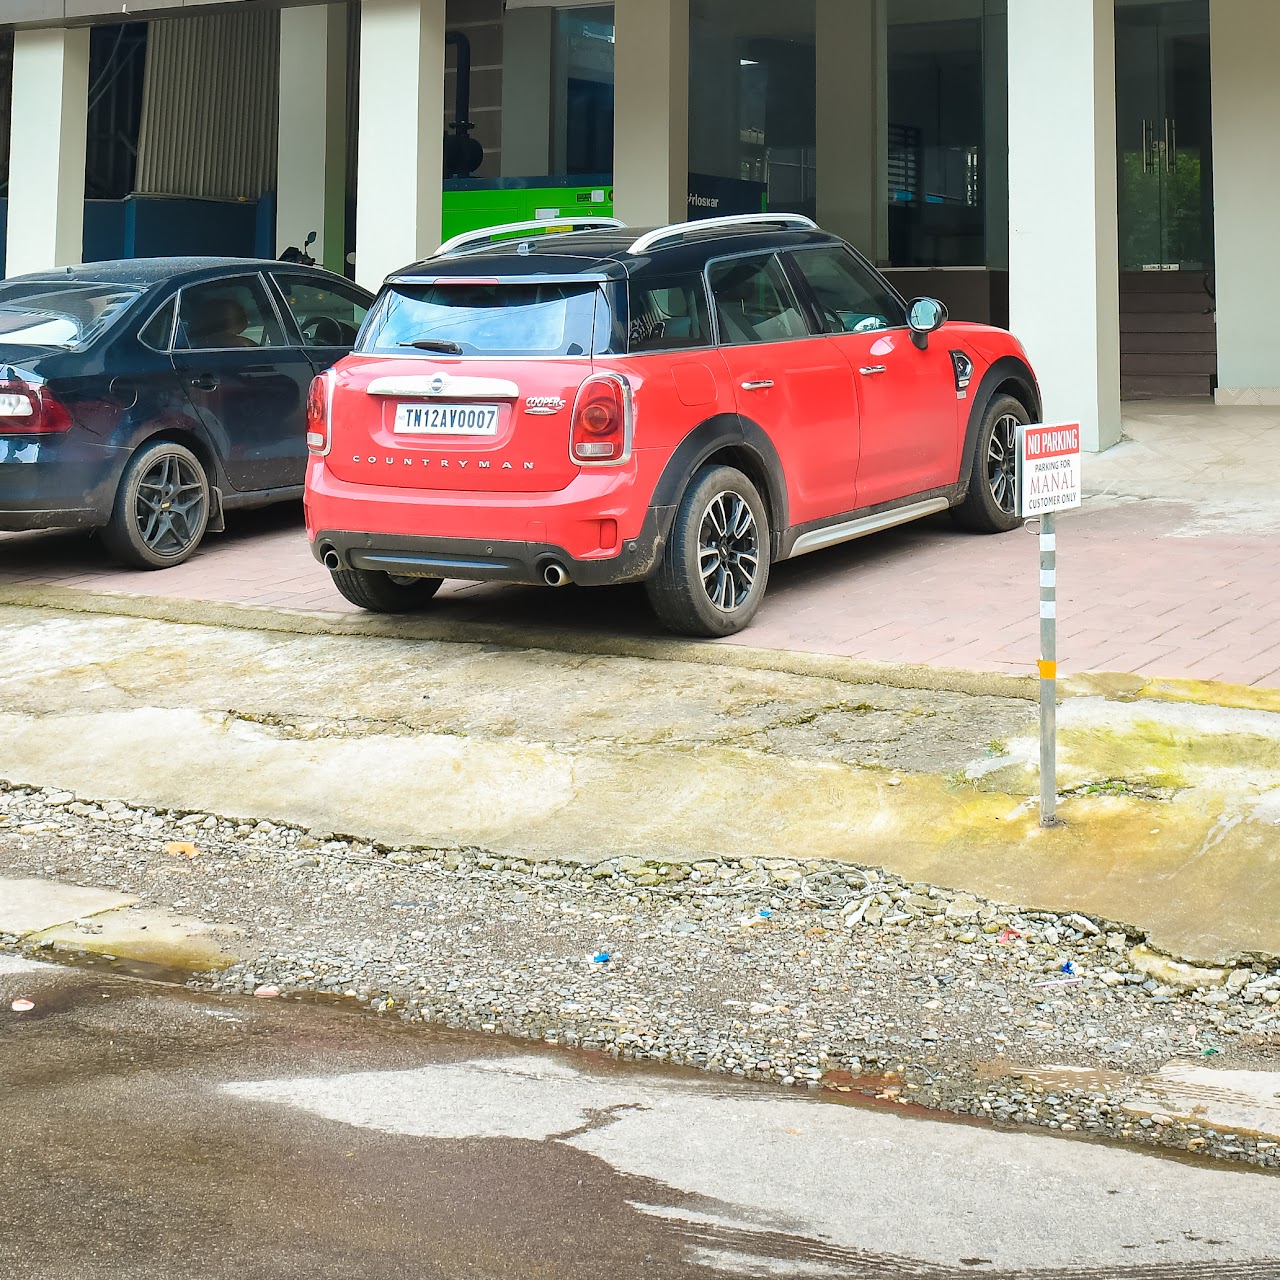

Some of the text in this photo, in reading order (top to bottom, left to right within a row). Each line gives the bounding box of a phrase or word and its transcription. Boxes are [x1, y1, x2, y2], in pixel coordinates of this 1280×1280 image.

[526, 396, 560, 408] COOPER
[406, 408, 496, 429] TN12AV0007
[1028, 429, 1078, 455] NO PARKING
[352, 455, 534, 470] COUNTRYMAN
[1035, 460, 1071, 472] PARKING FOR
[1030, 470, 1076, 495] MANAL
[1029, 493, 1077, 510] CUSTOMER ONLY
